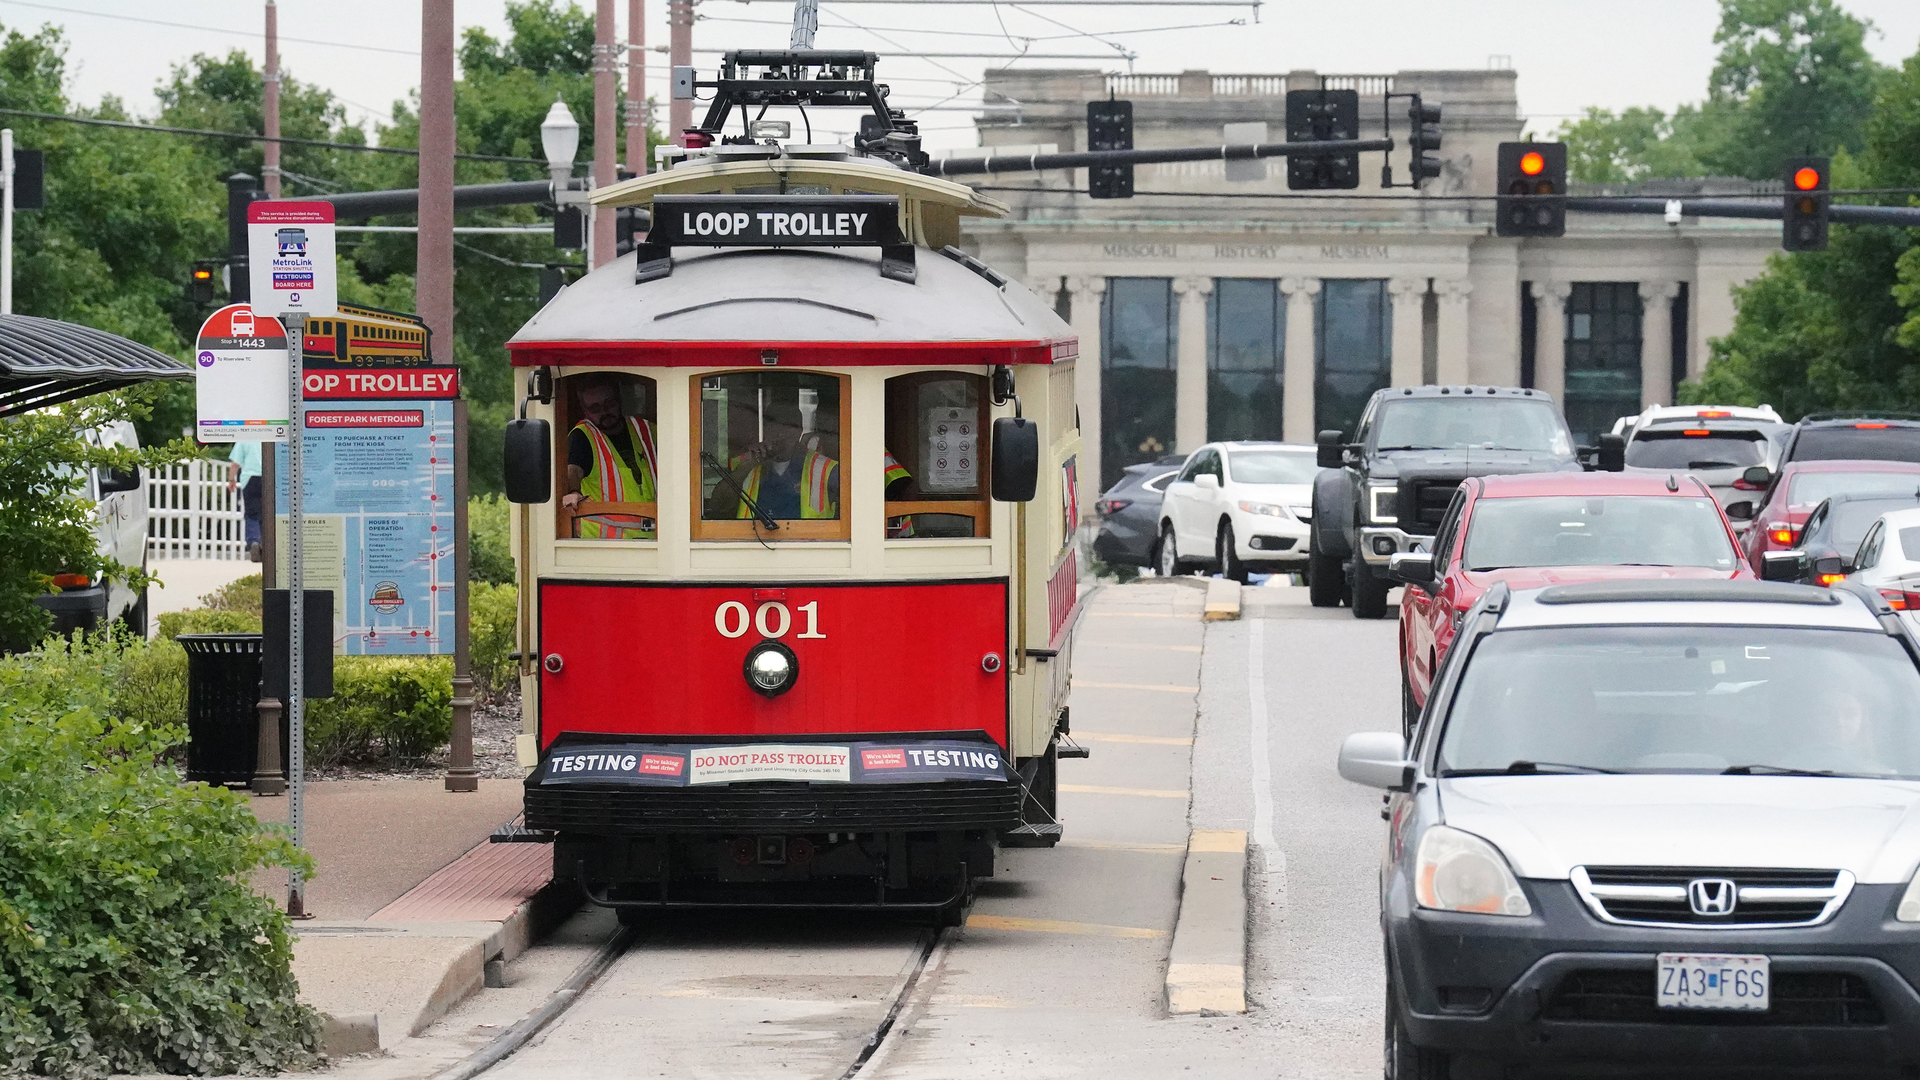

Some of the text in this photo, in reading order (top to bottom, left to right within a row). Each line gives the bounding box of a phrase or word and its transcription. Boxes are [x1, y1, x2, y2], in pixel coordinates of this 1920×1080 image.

[683, 212, 868, 236] LOOP TROLLEY
[1102, 245, 1389, 258] MISSOURI HISTORY MUSEUM
[238, 339, 266, 348] 1443
[302, 374, 453, 392] OP TROLLEY
[369, 415, 420, 423] METROLINK
[714, 601, 827, 639] 001
[551, 754, 637, 773] TESTING
[664, 759, 680, 768] taking
[695, 753, 846, 768] DO NOT PASS TROLLEY
[908, 750, 999, 770] TESTING
[1662, 967, 1764, 998] ZA3 F6S
